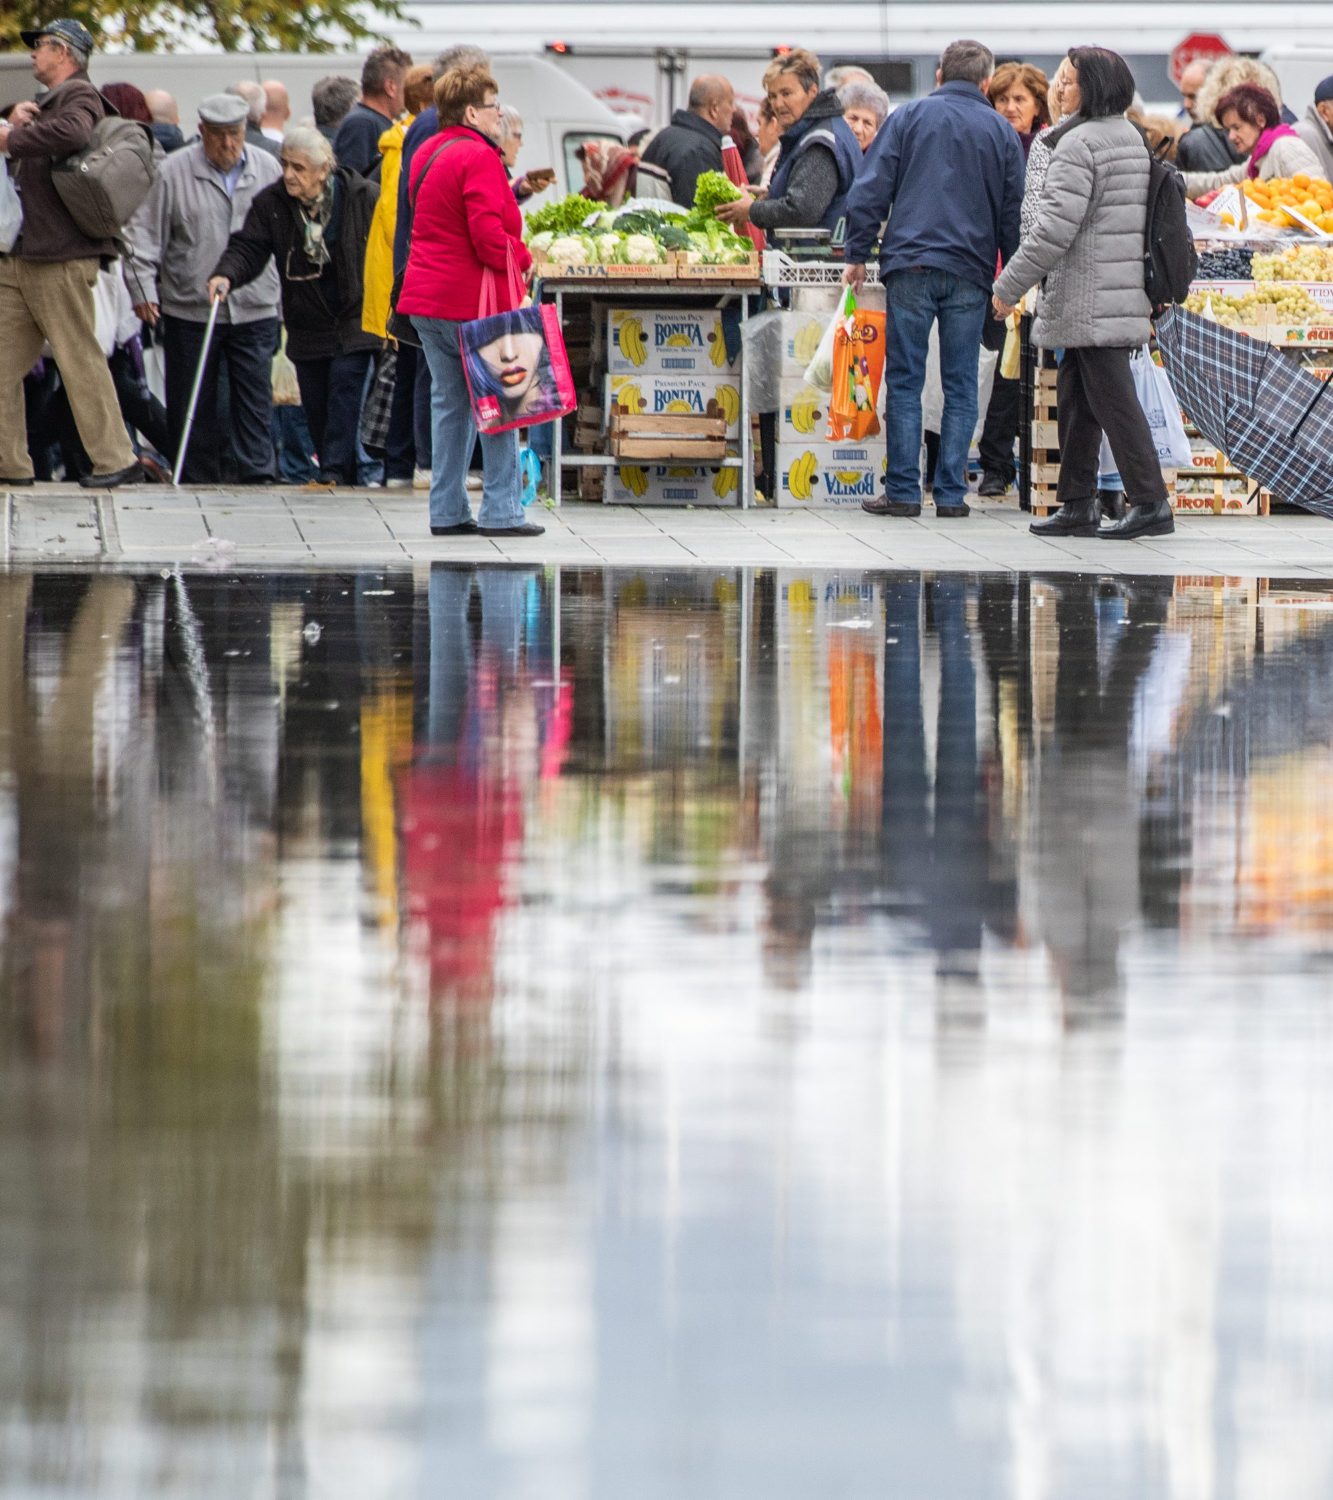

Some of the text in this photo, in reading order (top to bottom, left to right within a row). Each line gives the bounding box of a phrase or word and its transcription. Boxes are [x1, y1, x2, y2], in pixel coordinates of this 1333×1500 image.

[565, 265, 607, 275] ASTA
[654, 323, 704, 346] BONITA
[687, 379, 706, 387] PACK
[654, 389, 704, 412] BONITA
[823, 472, 875, 495] BONITA
